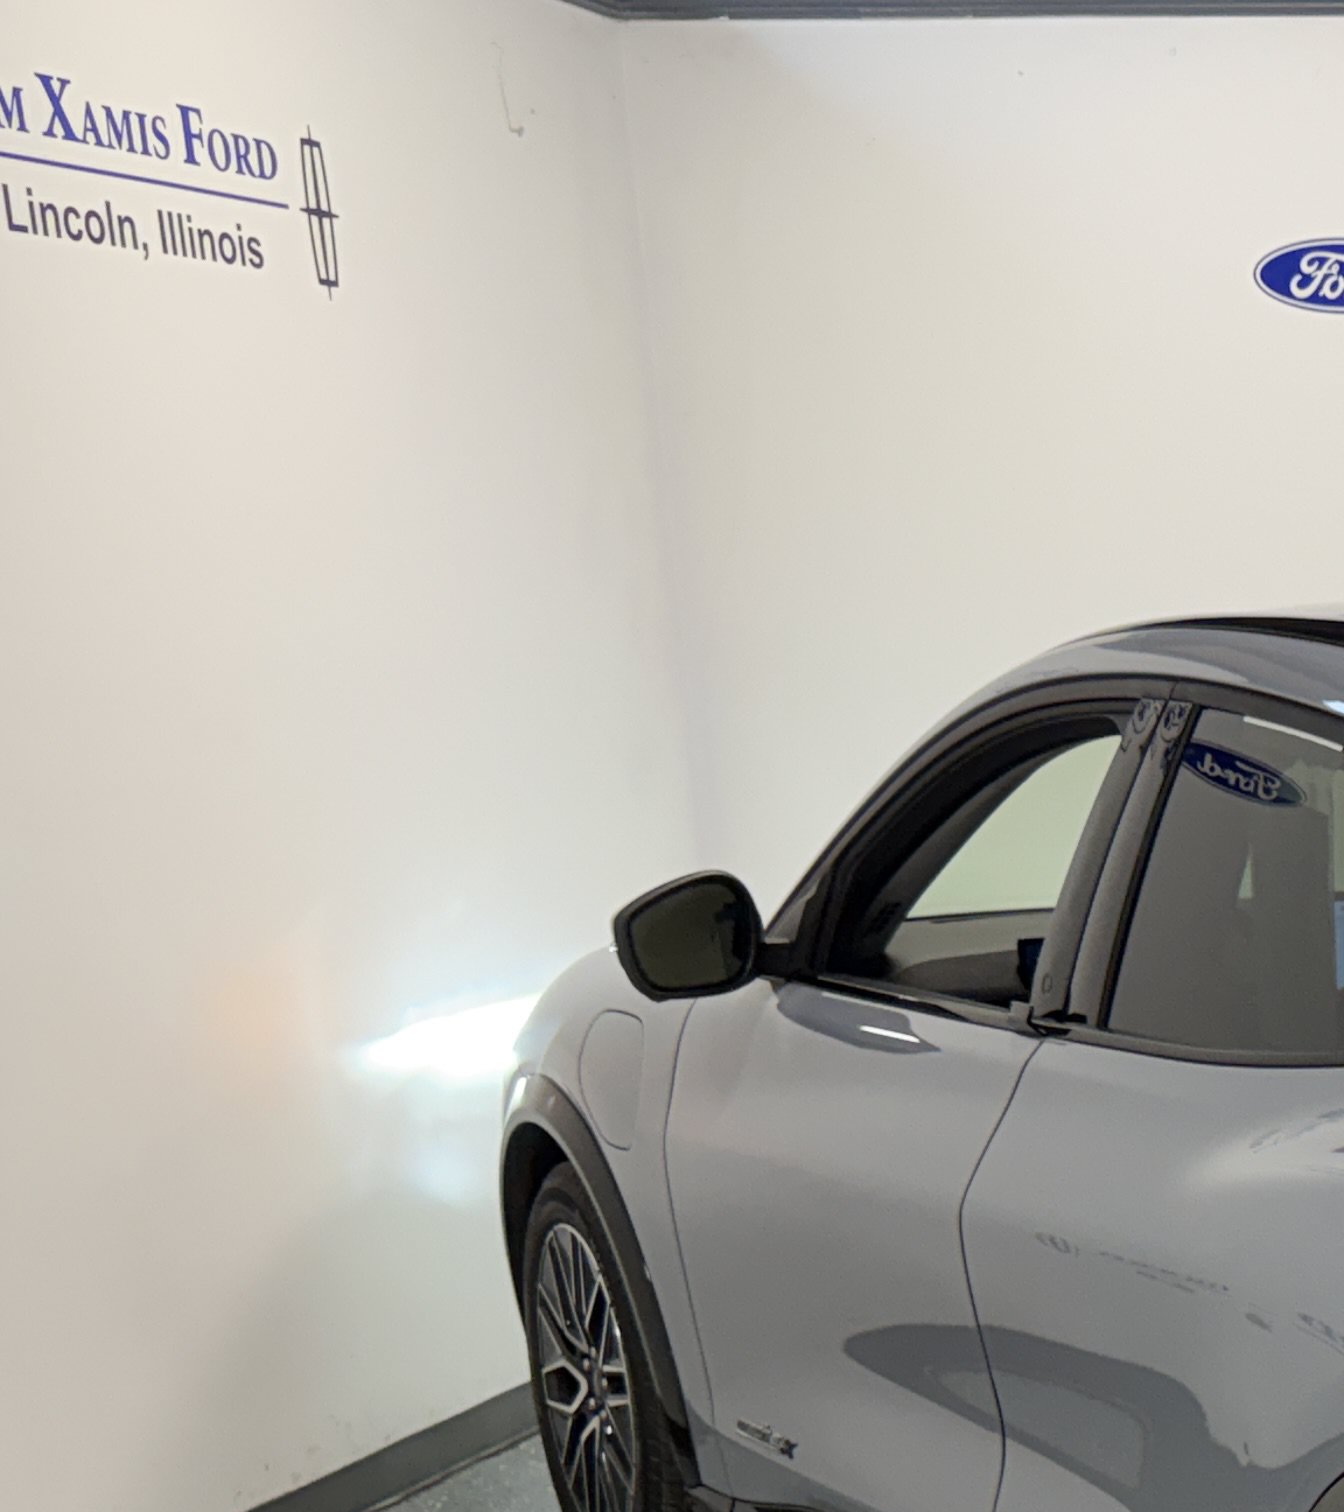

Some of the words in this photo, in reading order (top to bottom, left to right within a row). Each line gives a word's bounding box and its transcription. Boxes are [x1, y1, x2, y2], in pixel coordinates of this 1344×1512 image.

[33, 72, 170, 160] XAMIS
[176, 103, 278, 180] FORD
[2, 184, 149, 260] Lincoln,
[157, 209, 264, 269] Illinois
